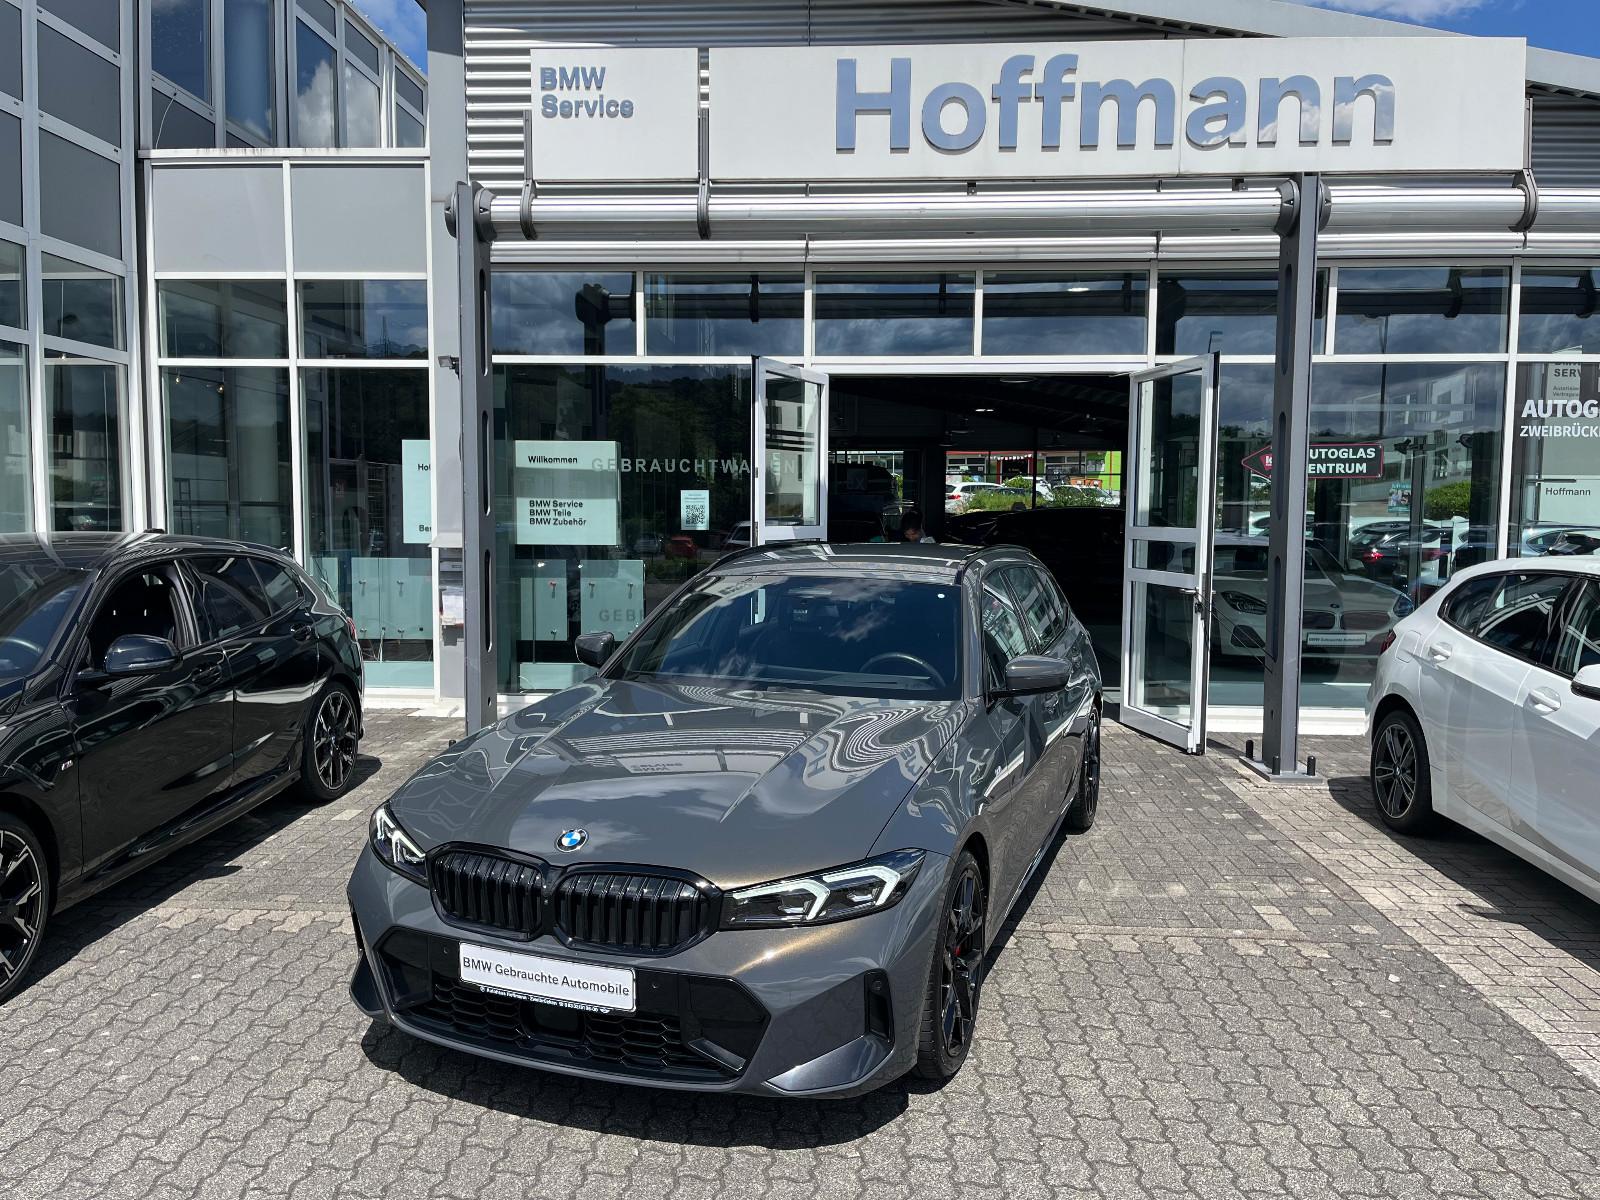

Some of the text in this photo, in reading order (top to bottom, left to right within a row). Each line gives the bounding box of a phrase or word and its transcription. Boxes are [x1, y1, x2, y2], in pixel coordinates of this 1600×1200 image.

[540, 66, 606, 91] BMW
[541, 94, 634, 119] Service
[836, 53, 1395, 153] Hoffmann
[1521, 399, 1600, 418] AUTOG
[1520, 422, 1600, 437] ZWEIBRÜCK
[1308, 447, 1376, 459] UTOGLAS
[528, 456, 578, 464] Willkommen
[591, 458, 795, 473] GEBRAUCHTWAEN
[1308, 462, 1367, 474] ENTRUM
[1545, 487, 1591, 496] Hoffmann
[529, 500, 584, 508] BMW Service
[529, 509, 572, 517] BMW Teile
[529, 517, 587, 526] BMW Zubehör
[462, 956, 630, 997] BMW Gebrauchte Automobile
